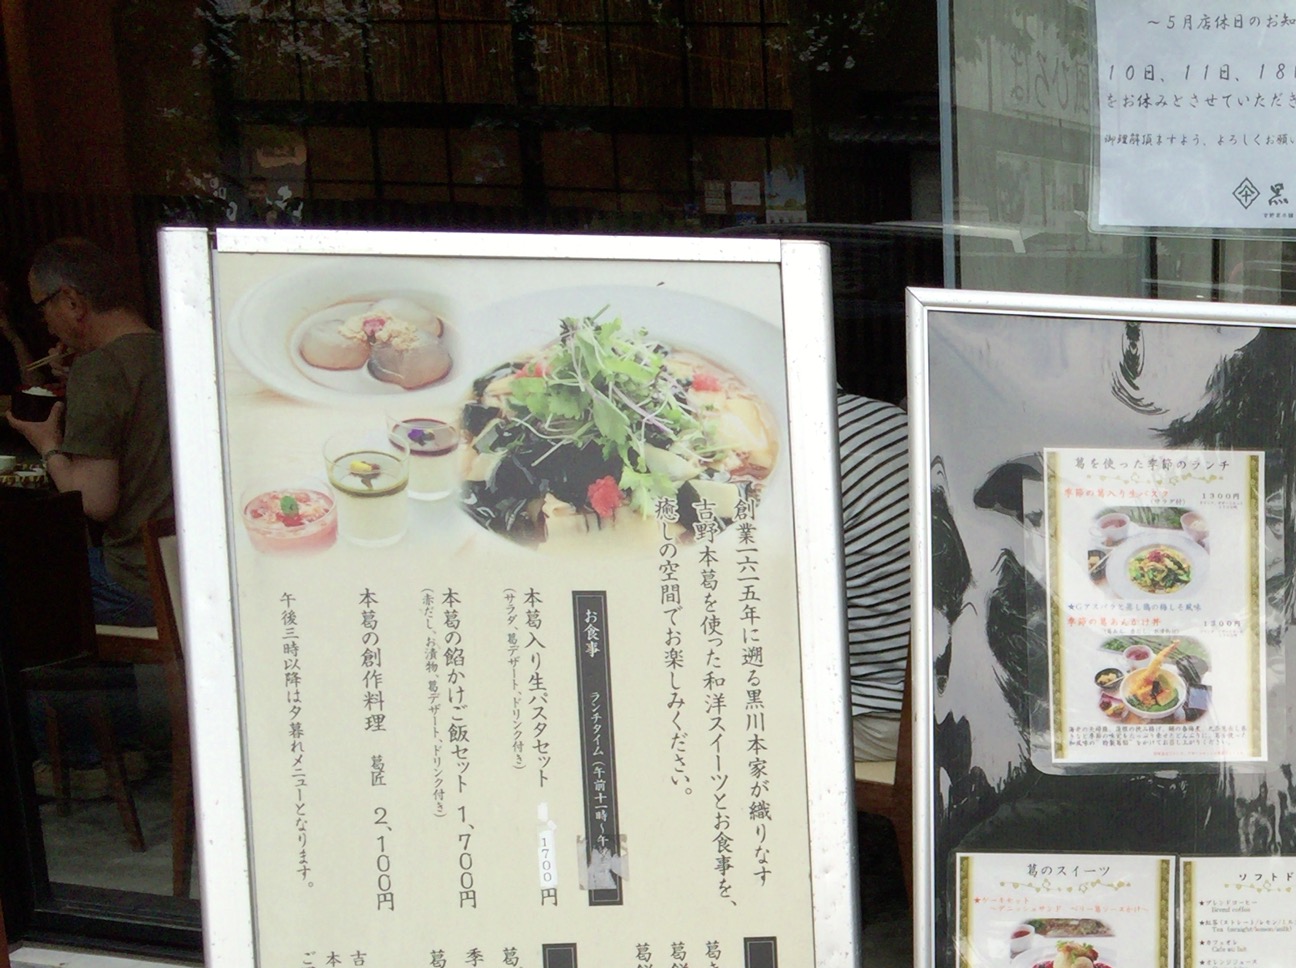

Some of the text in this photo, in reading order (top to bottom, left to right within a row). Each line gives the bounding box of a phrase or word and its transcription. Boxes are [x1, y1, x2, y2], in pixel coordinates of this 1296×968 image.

[358, 587, 387, 733] 本葛の創作料理
[441, 587, 471, 794] 本葛の餡かけご飯セット
[523, 587, 552, 788] 本葛入り生パスタセット
[584, 609, 601, 659] お食事
[654, 498, 693, 797] 癒しの空間でお楽しみください。
[692, 499, 738, 908] 吉野本葛を使った和洋スイーツとお食事を、
[733, 498, 773, 888] 創業一六一五年に遡る黒川本家が織りなす
[279, 591, 314, 889] 午後三時以降は夕暮れメニューとなります。
[370, 754, 387, 787] 葛匠
[1026, 863, 1111, 878] 葛のスイーツ
